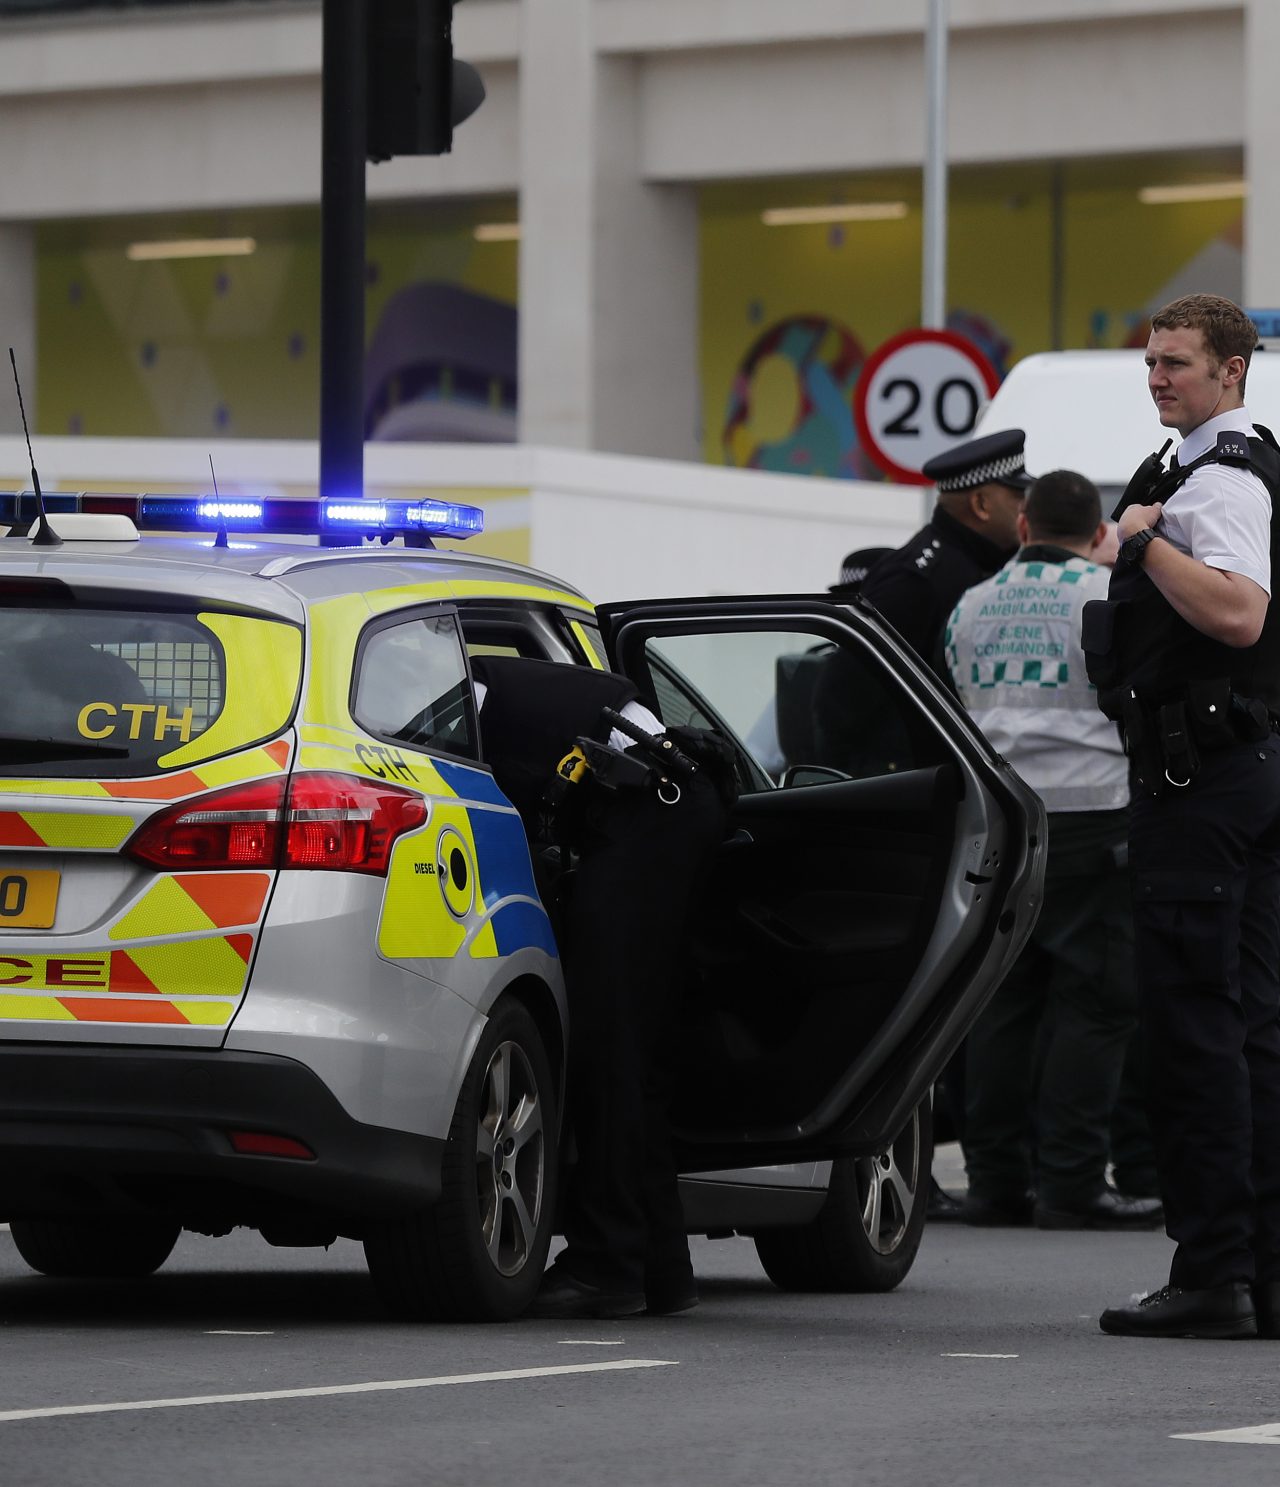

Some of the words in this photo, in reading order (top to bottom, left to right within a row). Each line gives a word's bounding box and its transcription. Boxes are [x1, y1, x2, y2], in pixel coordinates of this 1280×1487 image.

[881, 378, 978, 437] 20
[997, 586, 1060, 600] LONDON
[979, 602, 1070, 617] AMBULANCE
[974, 642, 1064, 658] COMMANDER
[77, 702, 193, 743] CTH
[354, 743, 420, 783] CTH
[414, 863, 436, 875] DIESEL
